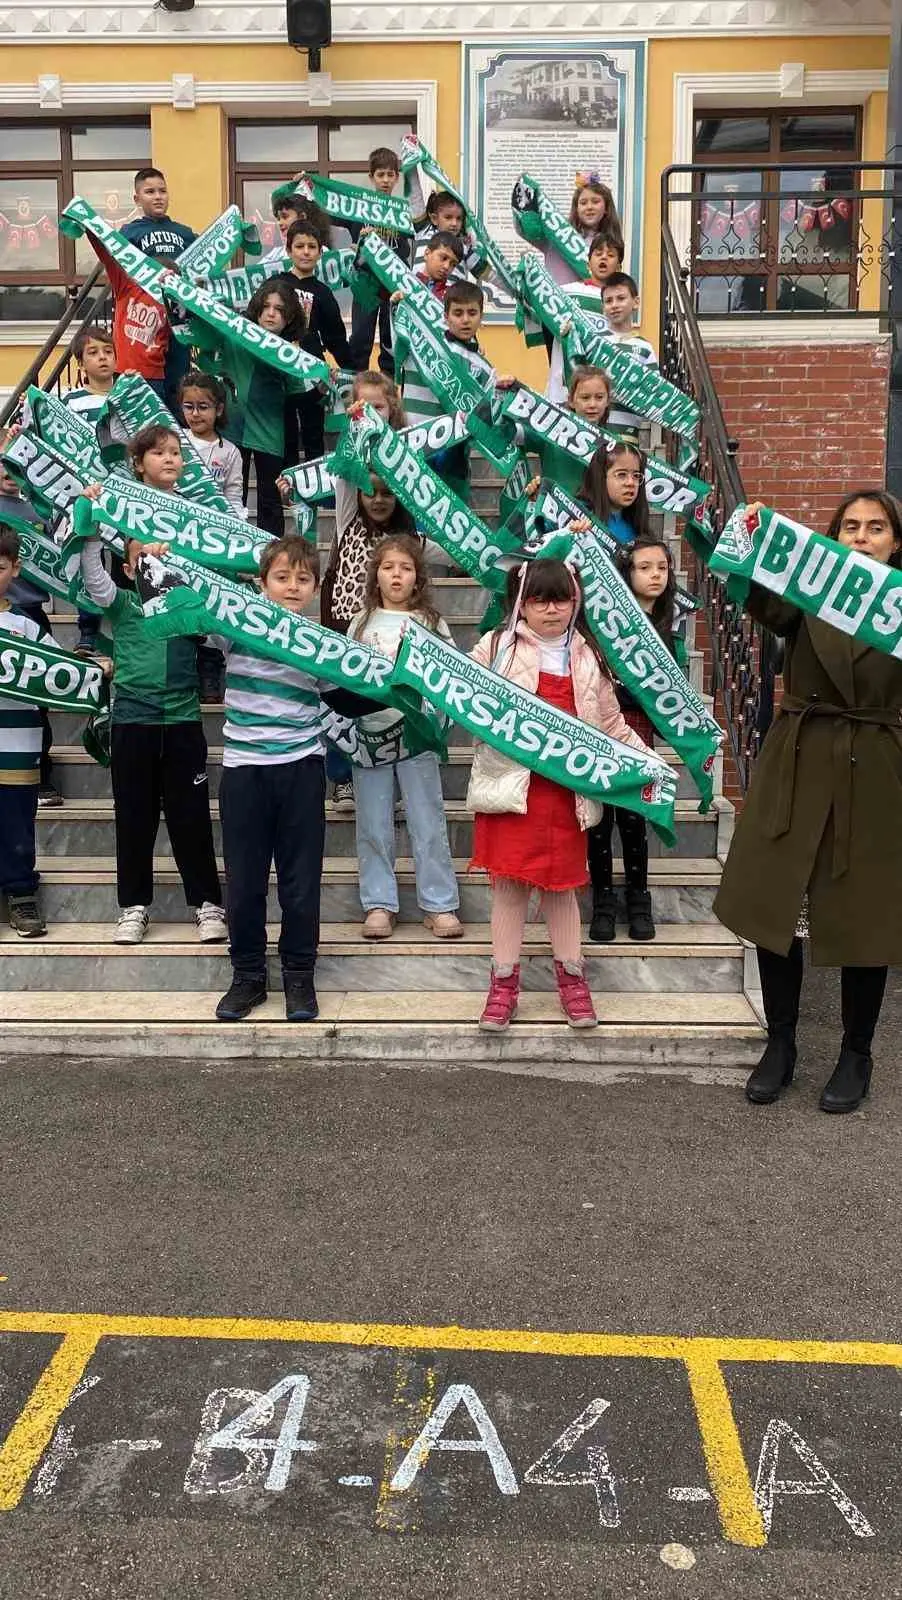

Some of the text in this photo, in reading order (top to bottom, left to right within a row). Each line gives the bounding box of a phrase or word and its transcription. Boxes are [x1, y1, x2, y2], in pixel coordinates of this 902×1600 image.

[326, 190, 415, 233] BURSAS
[141, 231, 184, 251] NATURE
[405, 646, 621, 790] BURSASPOR
